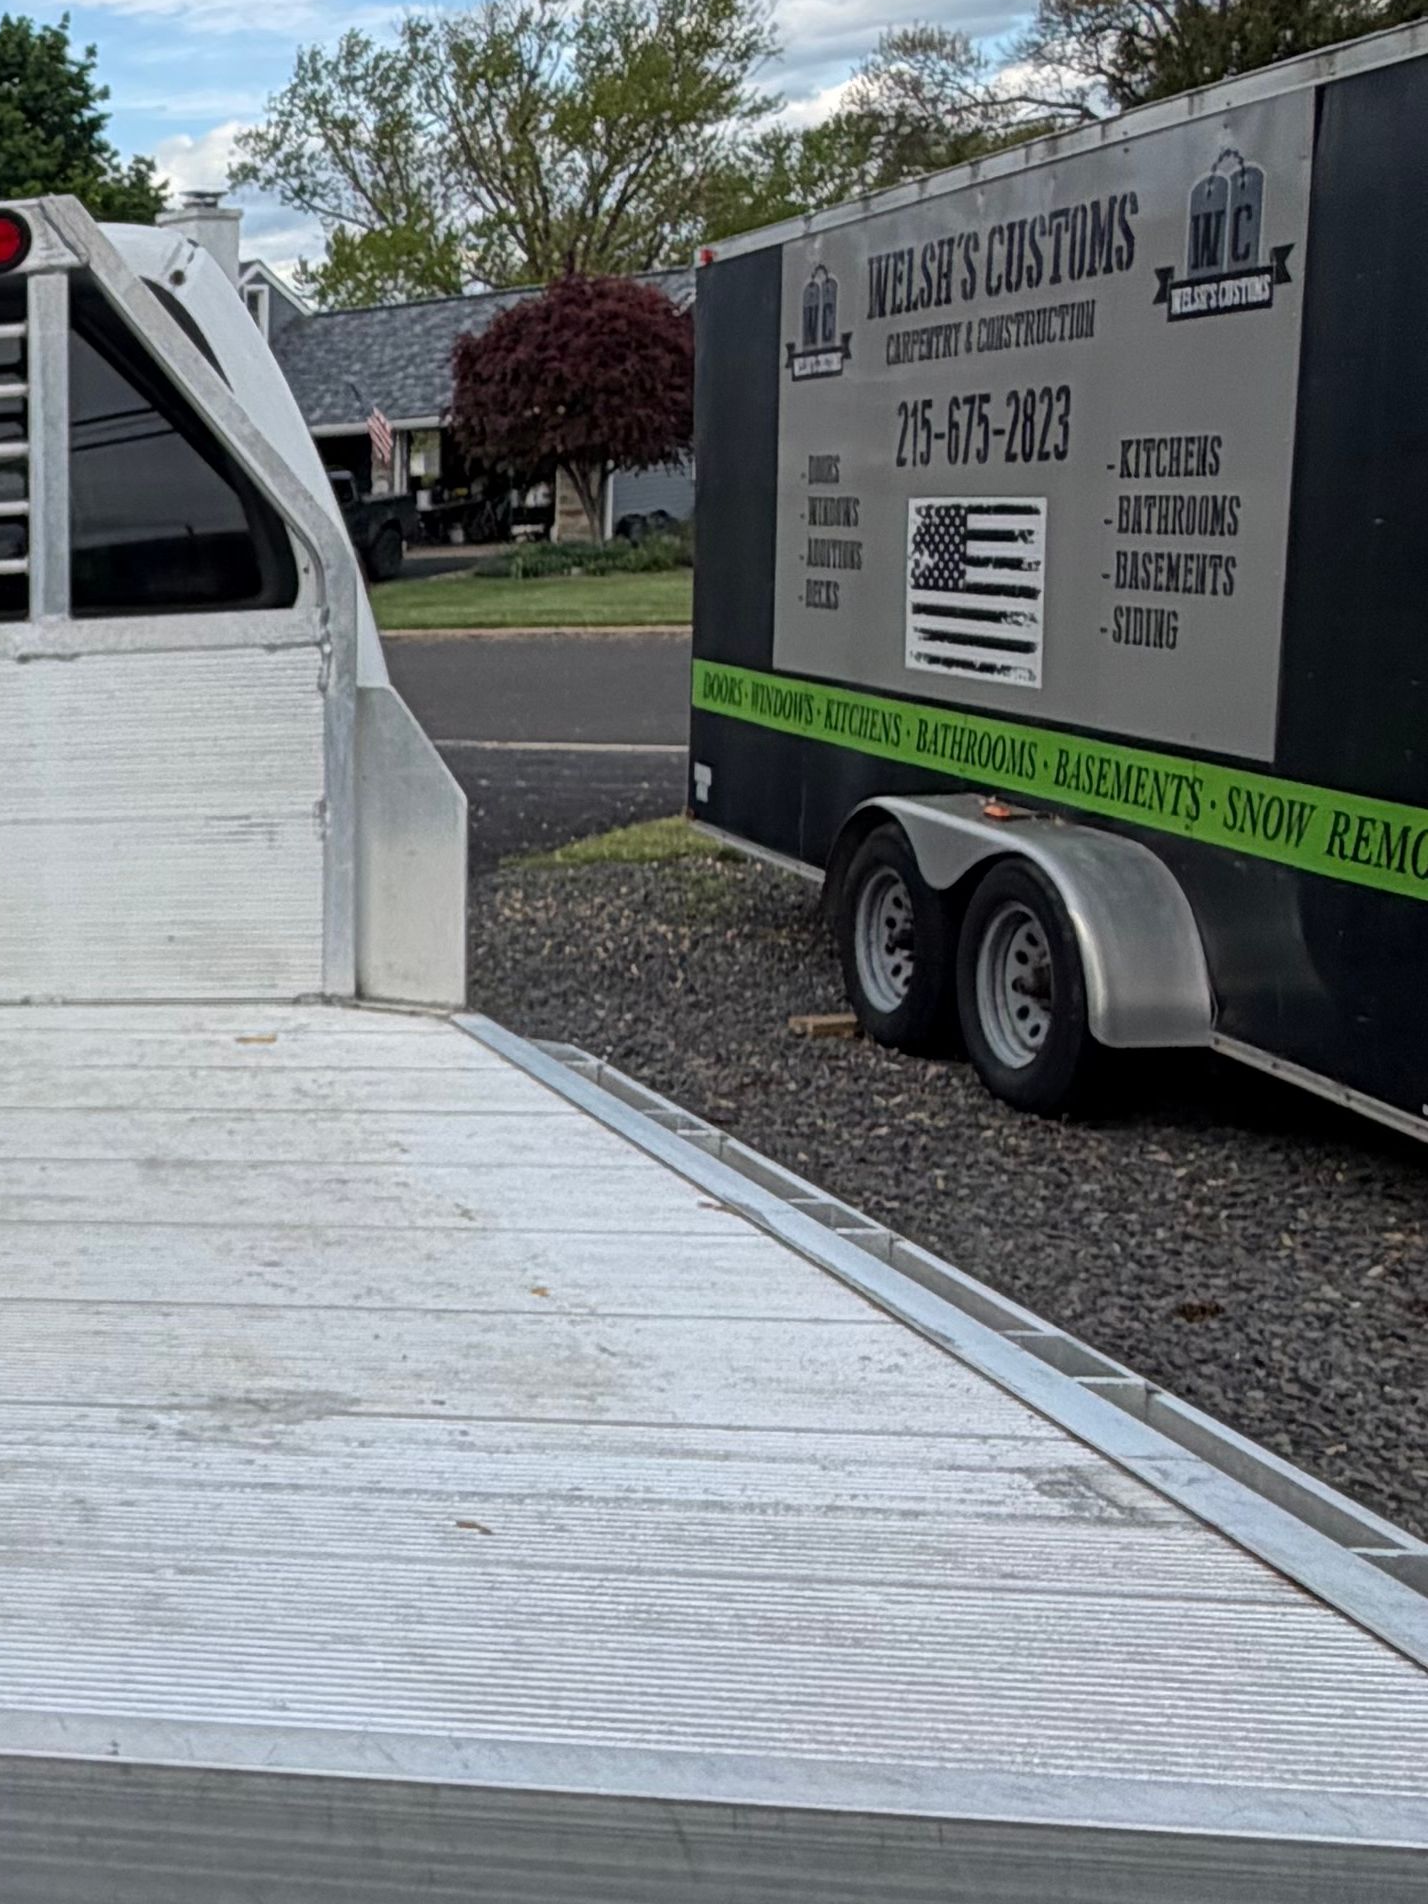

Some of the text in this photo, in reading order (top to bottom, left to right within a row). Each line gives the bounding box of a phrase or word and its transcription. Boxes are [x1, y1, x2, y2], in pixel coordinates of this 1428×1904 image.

[867, 191, 1139, 320] WELSH'S CUSTOMS
[886, 320, 963, 366] CARPENTRY
[976, 299, 1096, 354] CONSTRUCTION
[896, 384, 1071, 468] 215-675-2823
[702, 671, 742, 708] DOORS
[750, 680, 815, 726] WINDOWS
[824, 698, 902, 747] KITCHENS
[916, 718, 1038, 781] BATHROOMS
[1054, 748, 1204, 822] BASEMENTS
[1223, 785, 1317, 848] SNOW
